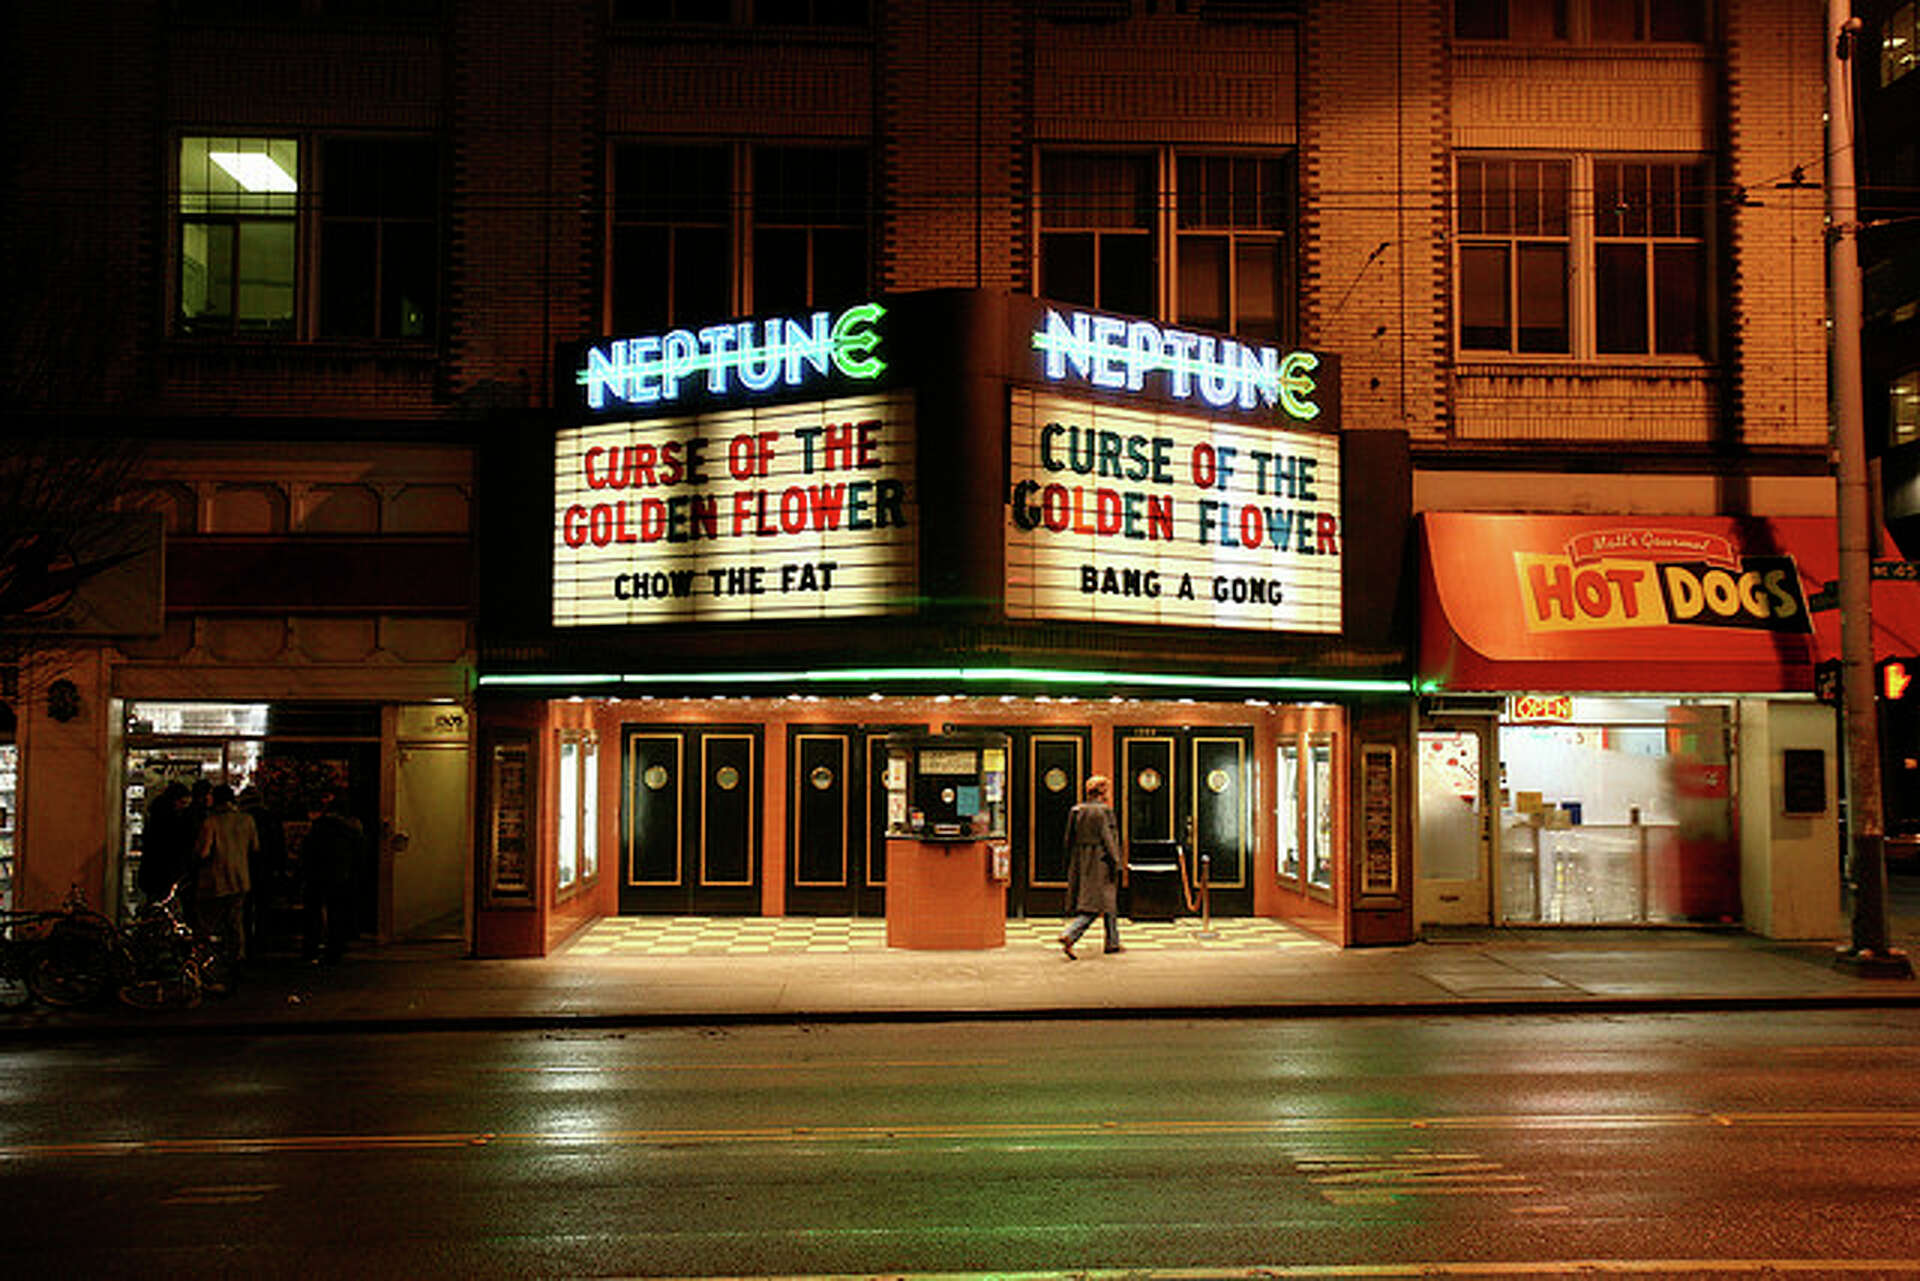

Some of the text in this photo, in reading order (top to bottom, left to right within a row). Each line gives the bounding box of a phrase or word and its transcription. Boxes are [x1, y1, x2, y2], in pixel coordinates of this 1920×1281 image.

[576, 302, 888, 409] NEPTUNE
[1031, 306, 1320, 421] NEPTUNE
[584, 420, 883, 490] CURSE OF THE
[1040, 422, 1318, 502] CURSE OF THE
[563, 478, 908, 549] GOLDEN FLOWER
[1012, 479, 1339, 556] GOLDEN FLOWER
[614, 562, 838, 600] CHOW THE FAT
[1080, 565, 1283, 606] BANG A GONG
[1527, 563, 1798, 621] HOT DOGS
[1517, 696, 1573, 718] OPEN
